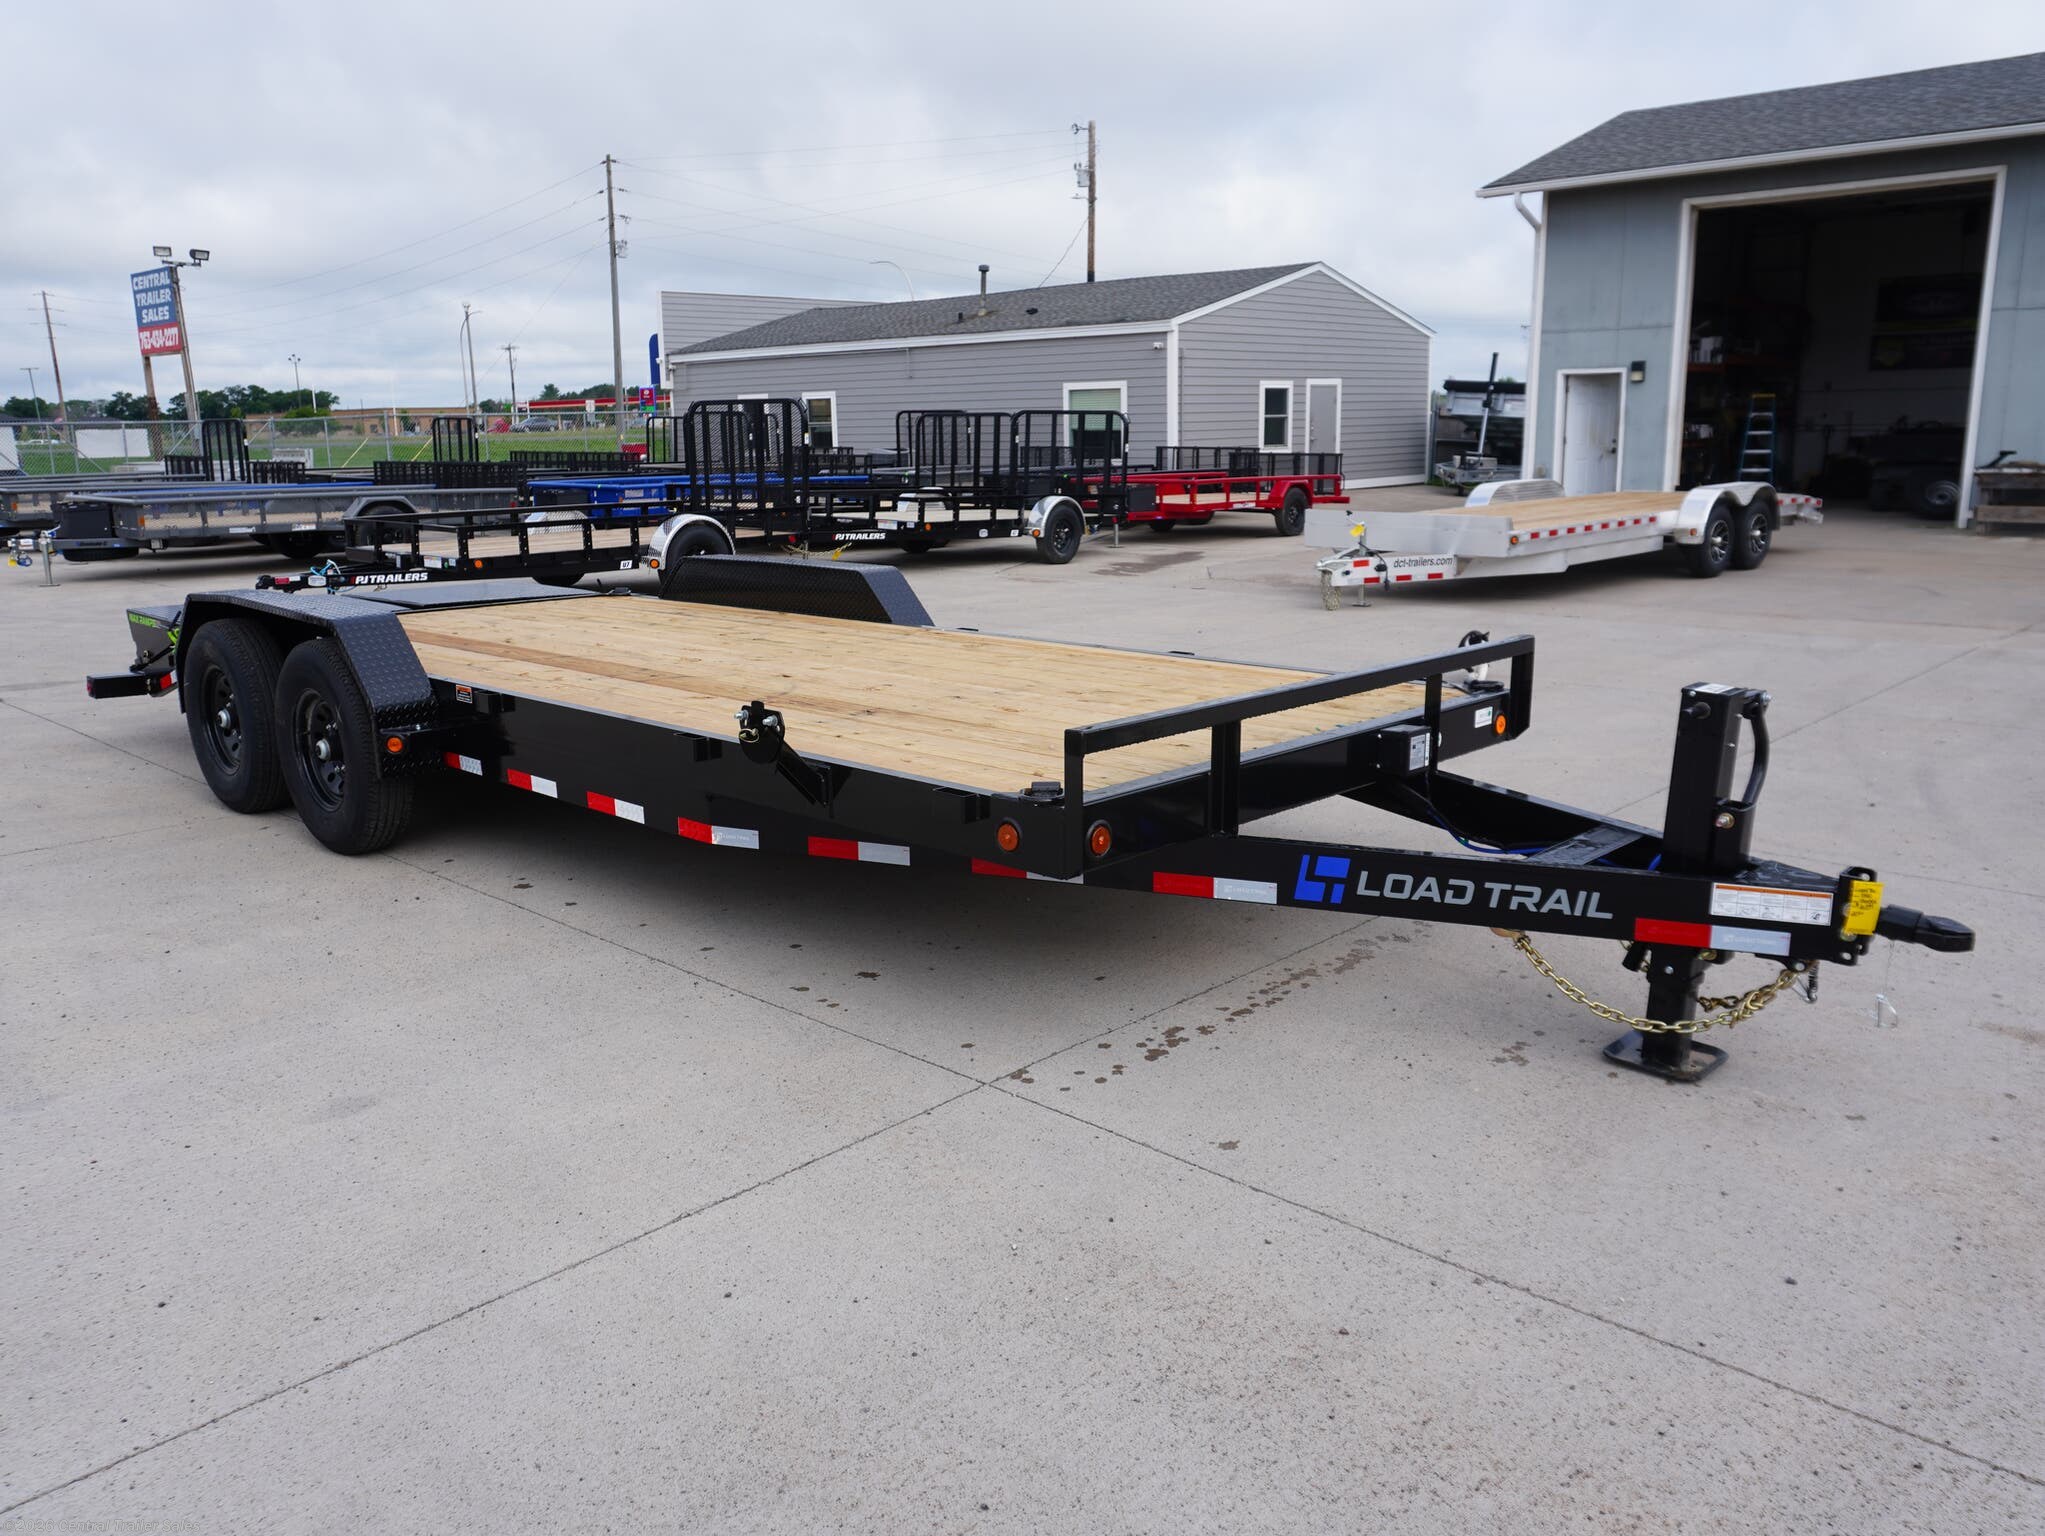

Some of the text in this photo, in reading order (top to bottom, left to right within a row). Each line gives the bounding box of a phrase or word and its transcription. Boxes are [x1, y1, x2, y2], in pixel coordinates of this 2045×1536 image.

[133, 271, 170, 289] CENTRAL
[136, 289, 172, 307] TRAILER
[142, 306, 169, 323] SALES
[845, 532, 886, 540] TRAILERS
[1393, 557, 1453, 568] dct-trailers.com
[369, 572, 428, 584] TRAILERS
[1356, 870, 1614, 920] LOAD TRAIL
